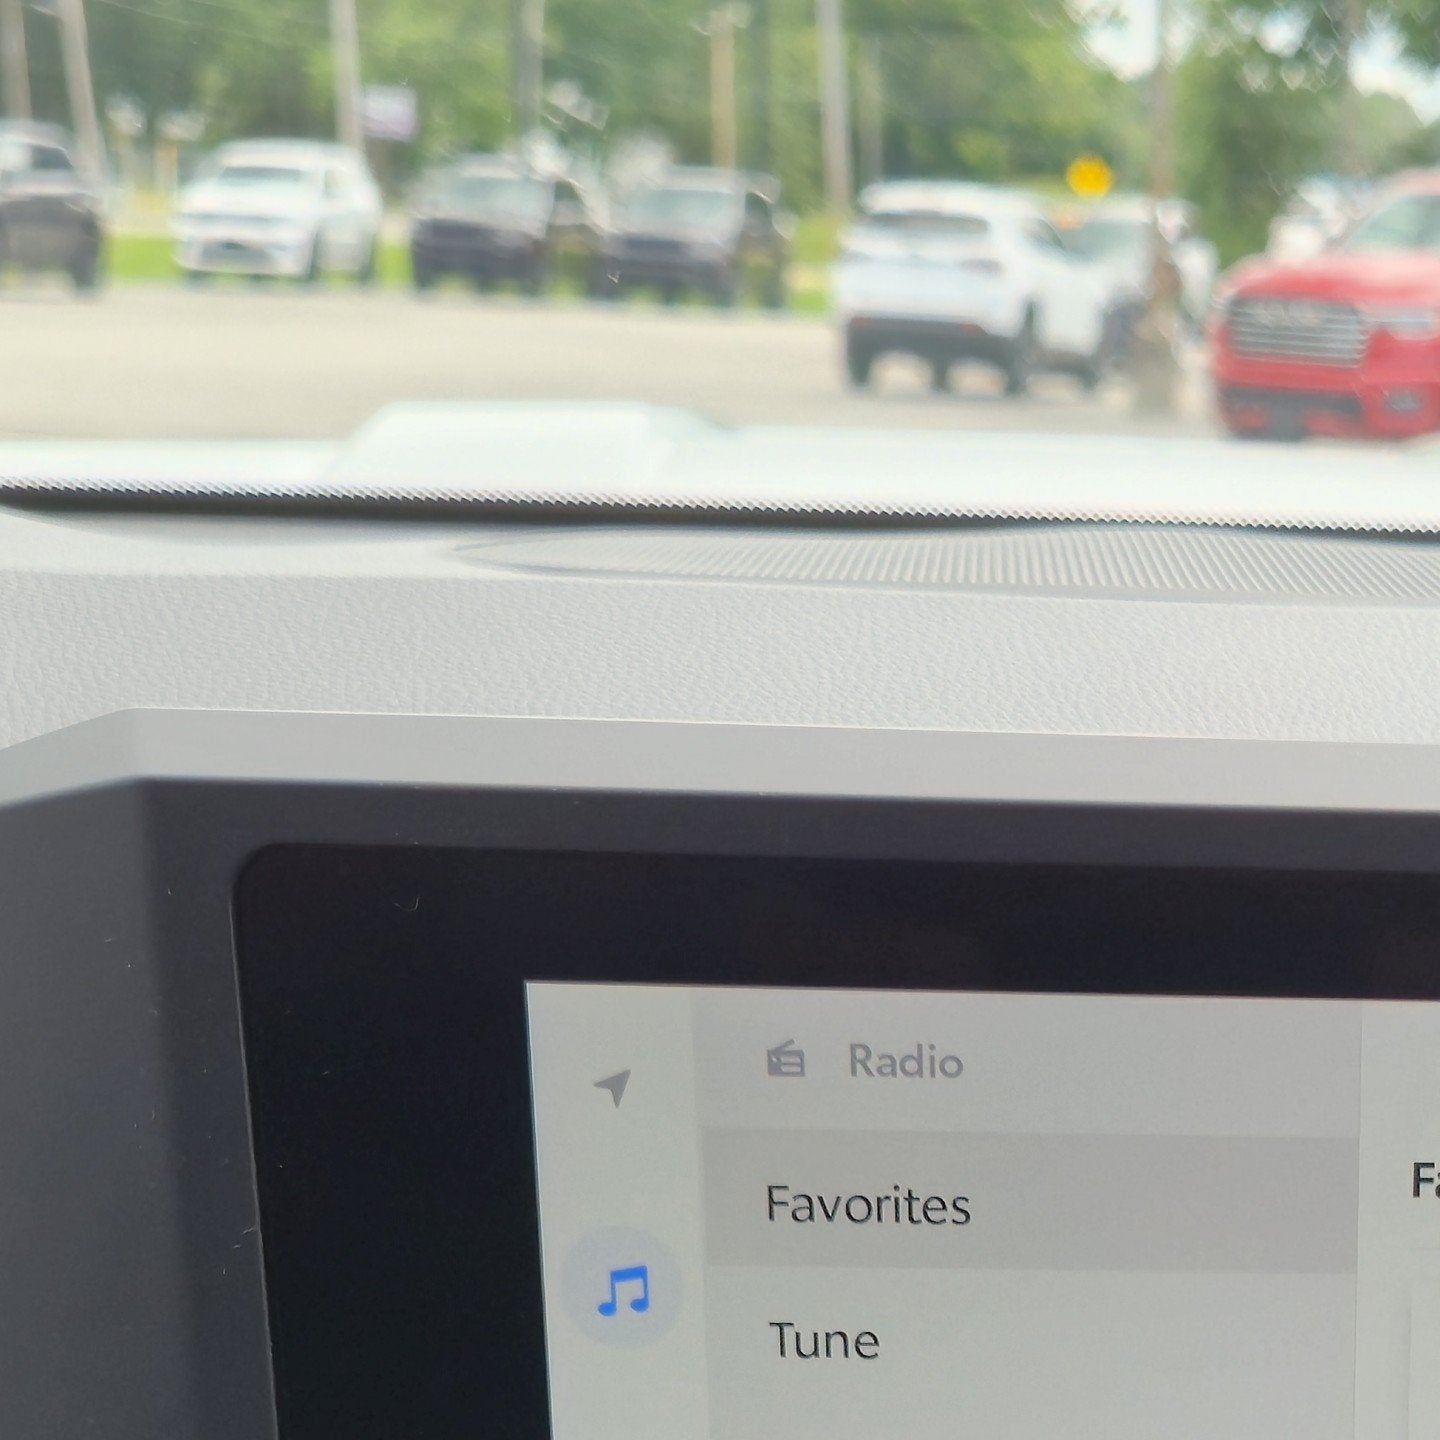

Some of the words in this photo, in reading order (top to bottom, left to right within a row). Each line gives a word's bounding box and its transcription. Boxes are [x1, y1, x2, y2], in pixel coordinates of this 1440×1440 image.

[849, 1043, 964, 1079] Radio
[765, 1183, 972, 1226] Favorites
[770, 1321, 881, 1361] Tune
